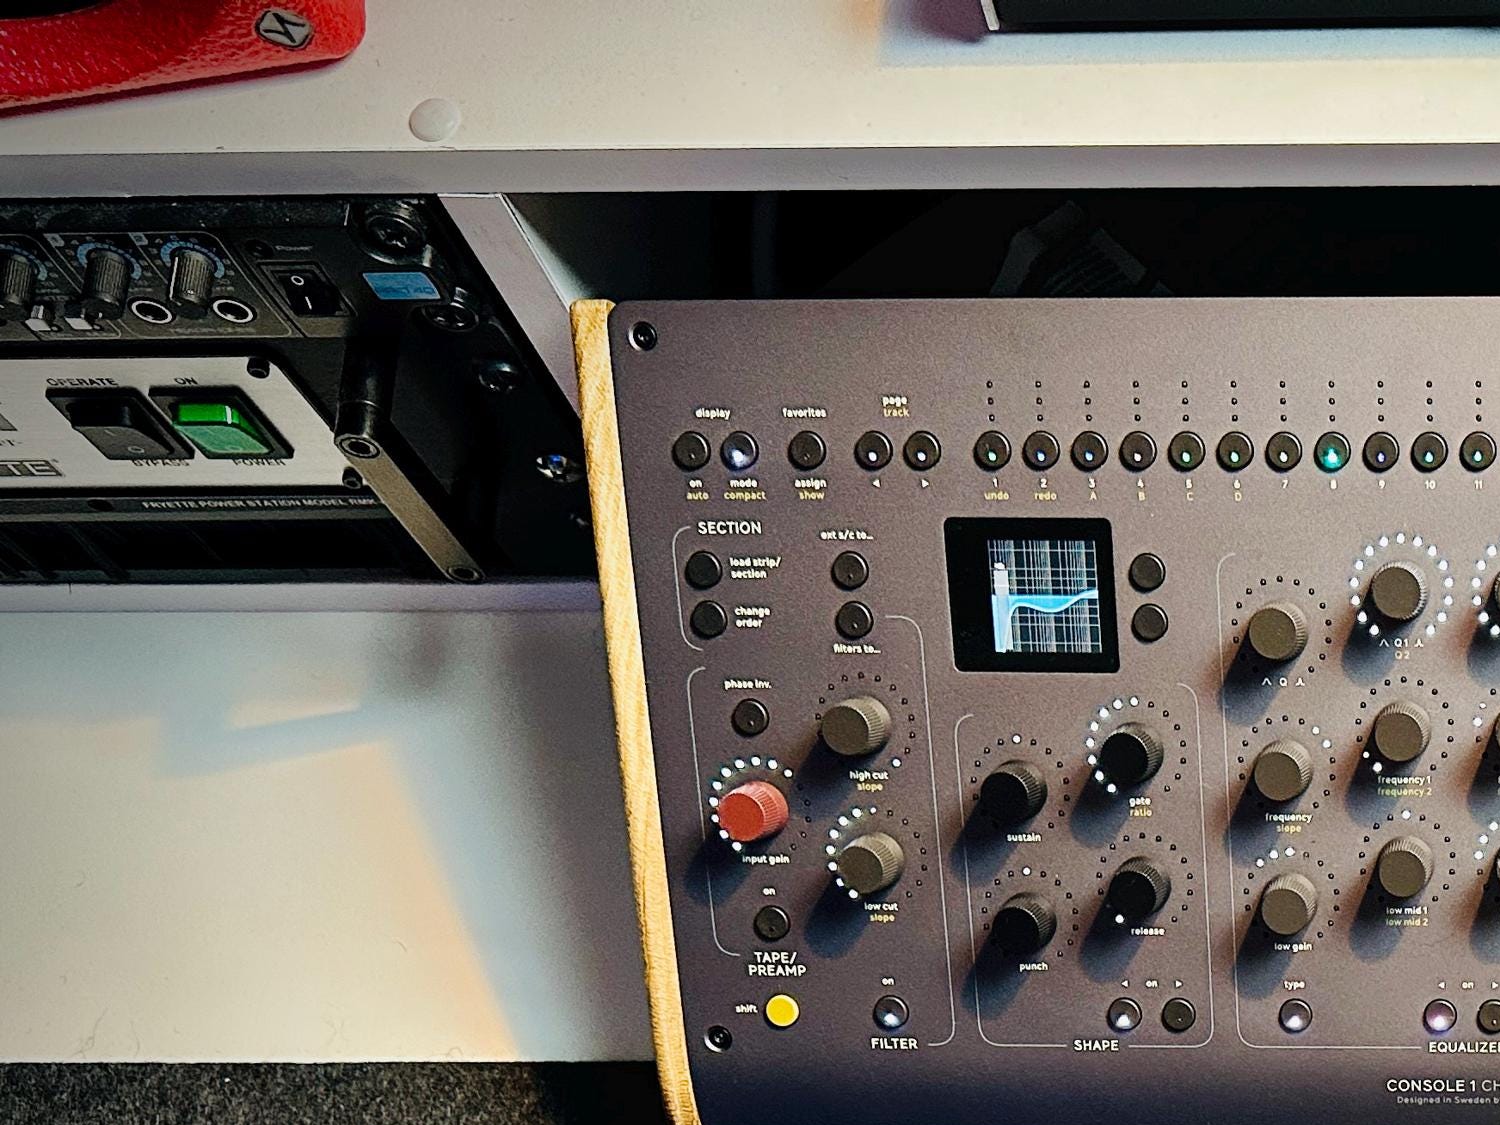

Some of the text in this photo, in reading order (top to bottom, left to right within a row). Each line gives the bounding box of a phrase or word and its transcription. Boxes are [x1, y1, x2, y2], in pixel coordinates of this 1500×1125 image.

[46, 377, 118, 387] OPERATE
[175, 377, 198, 386] ON
[882, 395, 908, 407] page
[695, 408, 731, 420] display
[782, 408, 827, 418] favorites
[883, 407, 910, 417] track
[730, 478, 758, 488] mode
[794, 478, 827, 490] assign
[1282, 479, 1288, 489] 7
[1425, 480, 1436, 489] 10
[686, 491, 709, 500] auto
[723, 491, 767, 501] compact
[799, 490, 825, 500] show
[985, 491, 1010, 500] undo
[1034, 491, 1057, 500] redo
[199, 500, 246, 508] POWER
[250, 499, 300, 508] STATION
[303, 498, 343, 506] MODEL
[697, 521, 762, 535] SECTION
[730, 557, 782, 569] load strip/
[731, 569, 767, 579] section
[735, 607, 770, 618] change
[736, 618, 762, 628] order
[724, 679, 772, 690] phase inv.
[850, 770, 889, 781] high cut
[1129, 797, 1151, 807] gate
[1130, 808, 1152, 817] ratio
[1265, 812, 1312, 824] frequency
[1007, 833, 1042, 842] sustain
[742, 854, 790, 865] input gain
[869, 913, 895, 923] slope
[754, 951, 797, 965] TAPE/
[748, 965, 807, 977] PREAMP
[1019, 962, 1048, 972] punch
[1284, 980, 1305, 990] type
[735, 1004, 758, 1013] shift
[871, 1037, 918, 1050] FILTER
[1073, 1040, 1119, 1051] SHAPE
[1386, 1079, 1465, 1092] CONSOLE
[1469, 1079, 1476, 1092] 1
[1397, 1096, 1440, 1106] Designed
[1442, 1096, 1452, 1105] in
[1453, 1096, 1491, 1105] Sweden
